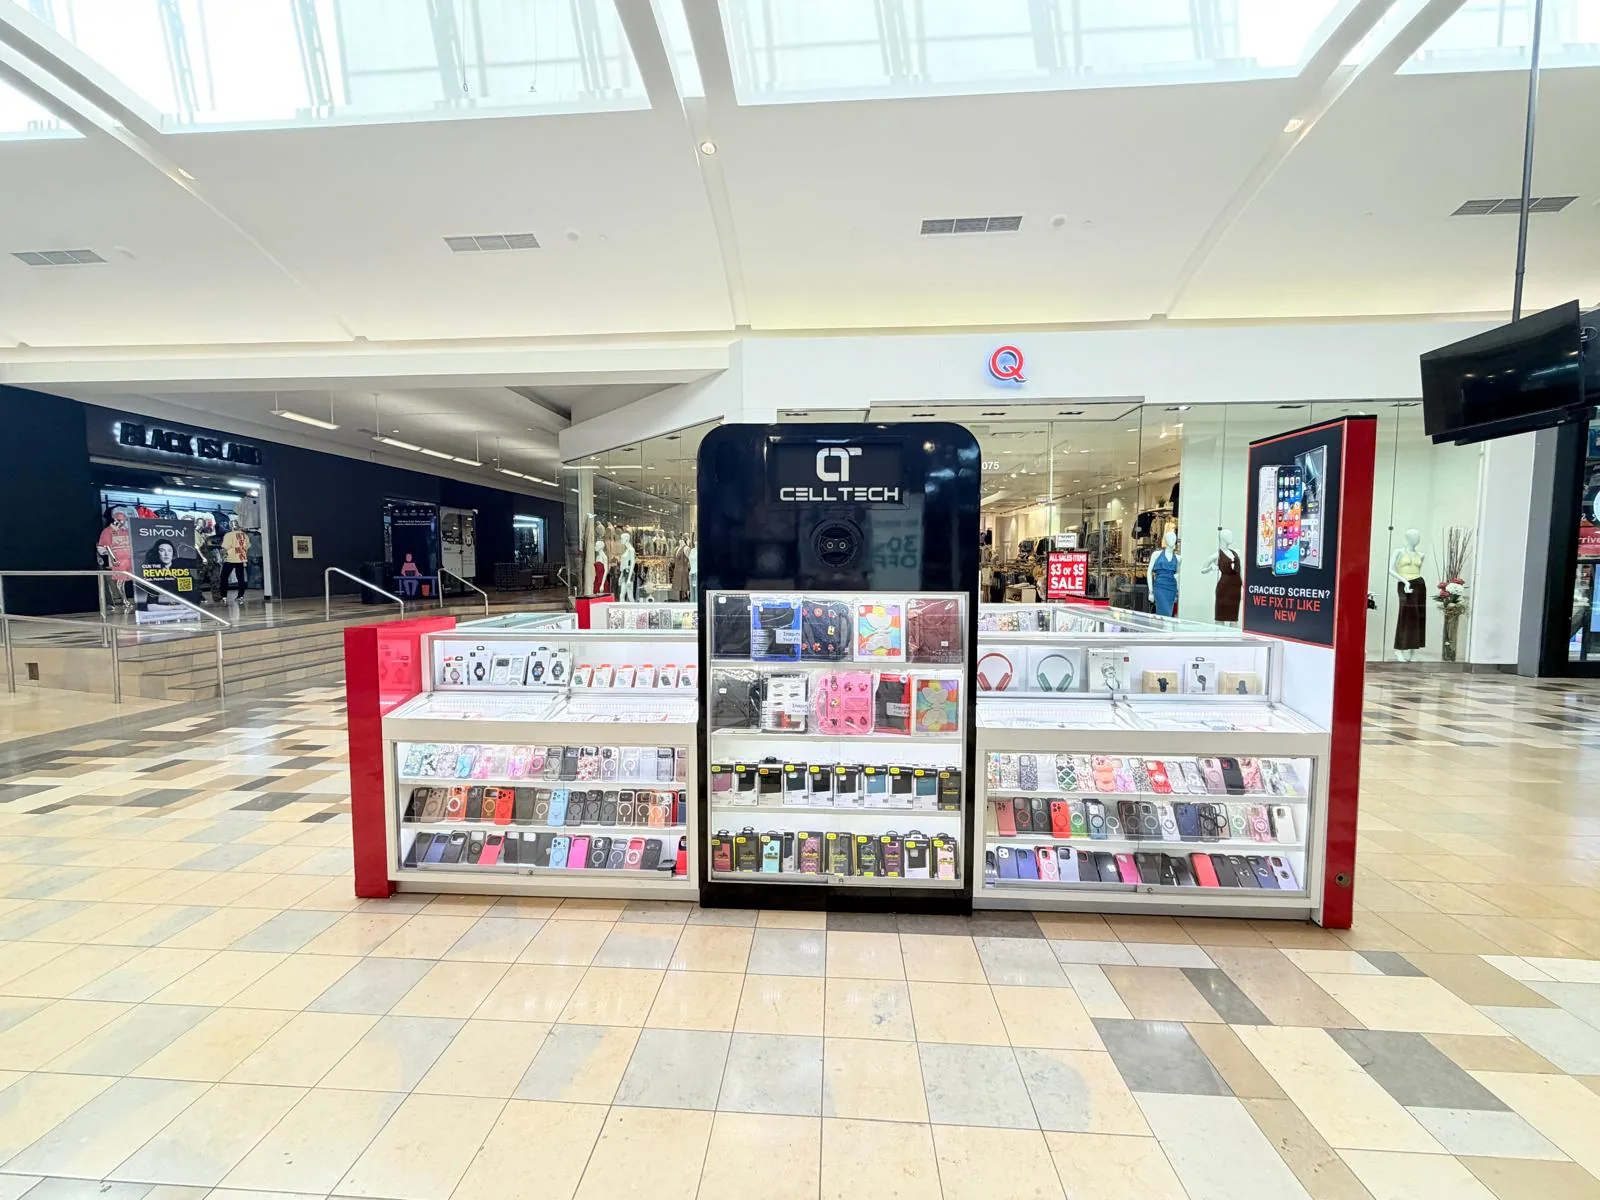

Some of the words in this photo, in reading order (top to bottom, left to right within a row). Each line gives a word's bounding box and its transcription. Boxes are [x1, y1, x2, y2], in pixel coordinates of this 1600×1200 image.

[990, 345, 1026, 382] Q
[120, 422, 194, 456] BLACK
[197, 437, 262, 466] ISLAND
[1049, 554, 1058, 562] ALL
[143, 568, 190, 577] REWARDS
[1050, 563, 1062, 577] $3
[1063, 567, 1072, 576] or
[1073, 563, 1084, 577] $5
[1051, 577, 1083, 590] SALE
[1248, 585, 1285, 596] CRACKED
[1287, 587, 1331, 599] SCREEN?
[1253, 595, 1267, 606] WE
[1268, 597, 1283, 609] FIX
[1285, 598, 1295, 609] IT
[1297, 599, 1321, 612] LIKE
[1274, 610, 1297, 623] NEW
